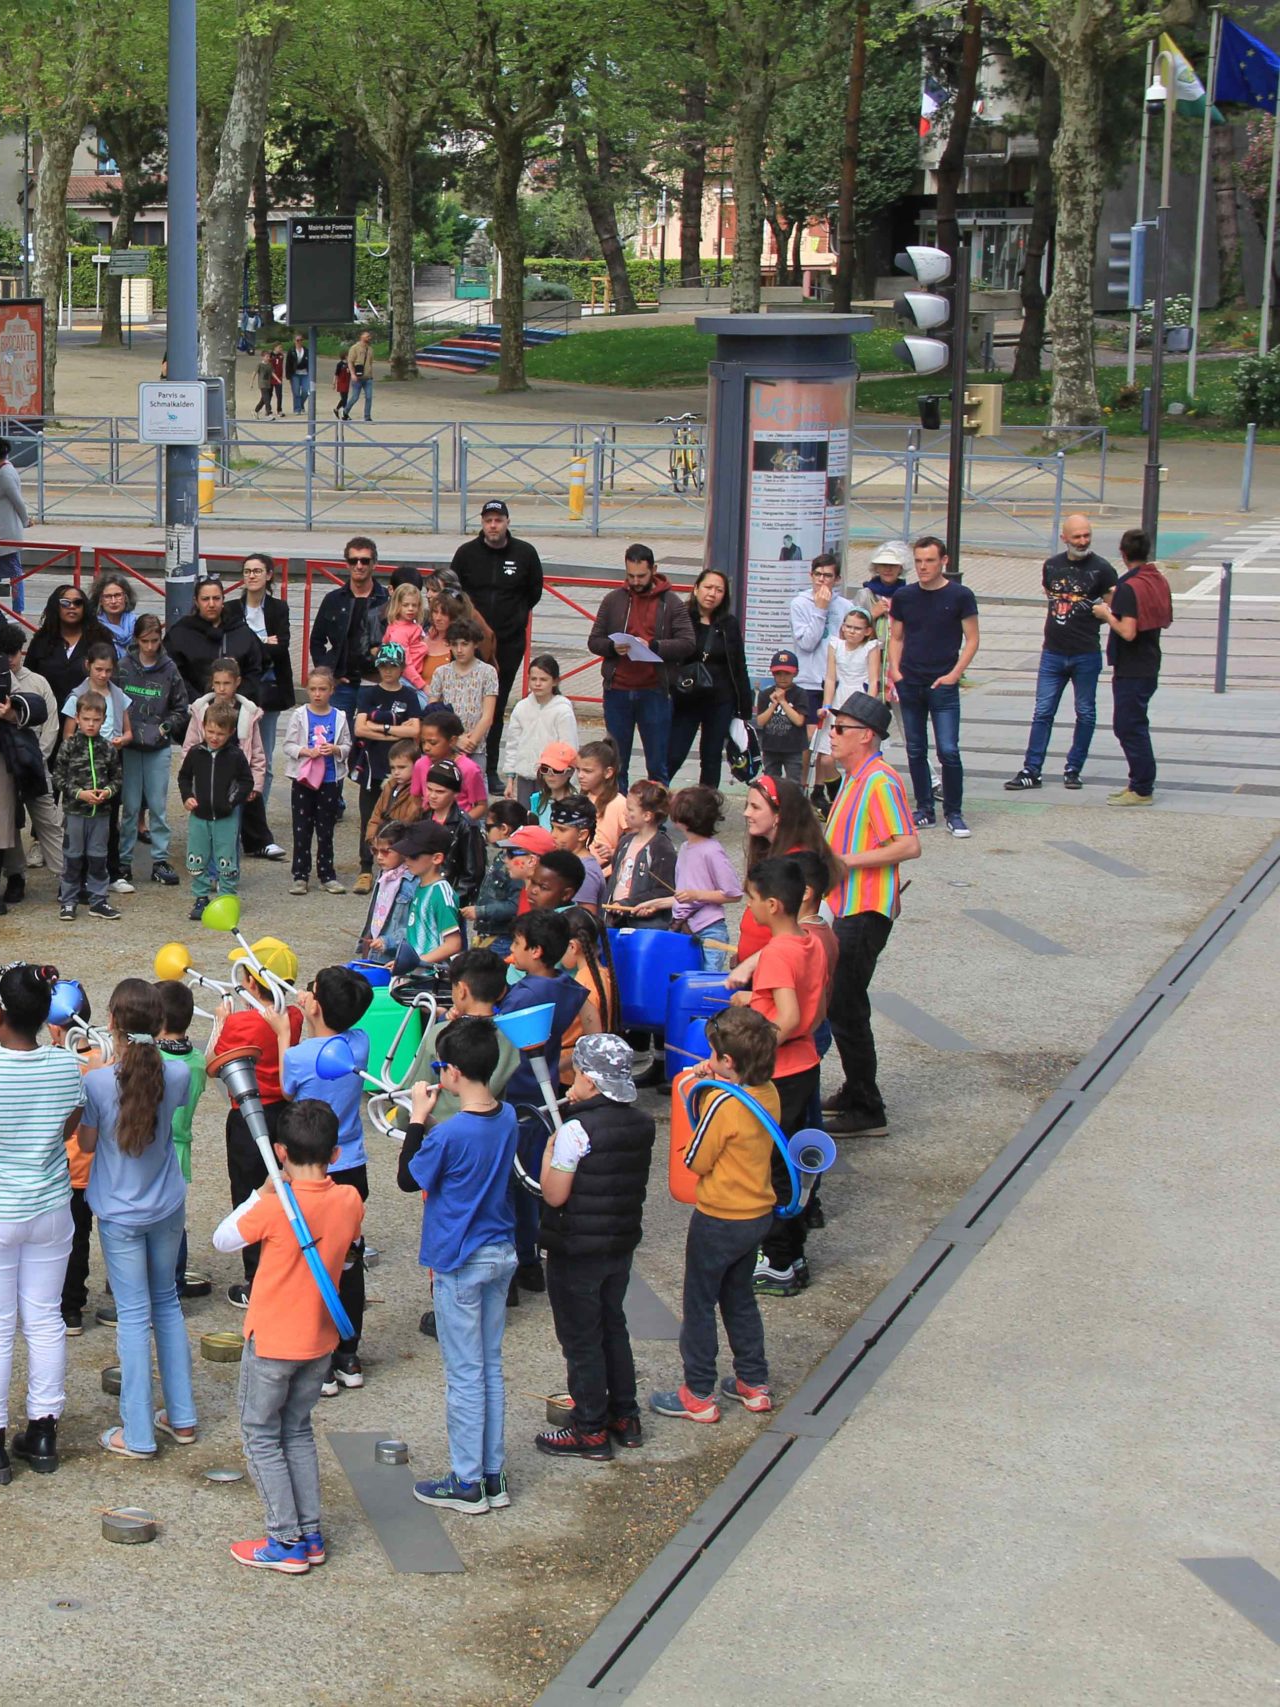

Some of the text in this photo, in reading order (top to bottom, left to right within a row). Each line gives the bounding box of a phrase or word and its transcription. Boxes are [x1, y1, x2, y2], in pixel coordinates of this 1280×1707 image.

[158, 391, 178, 399] Parvis
[149, 400, 195, 408] Schmalkalden
[124, 684, 161, 698] MINECRAFT
